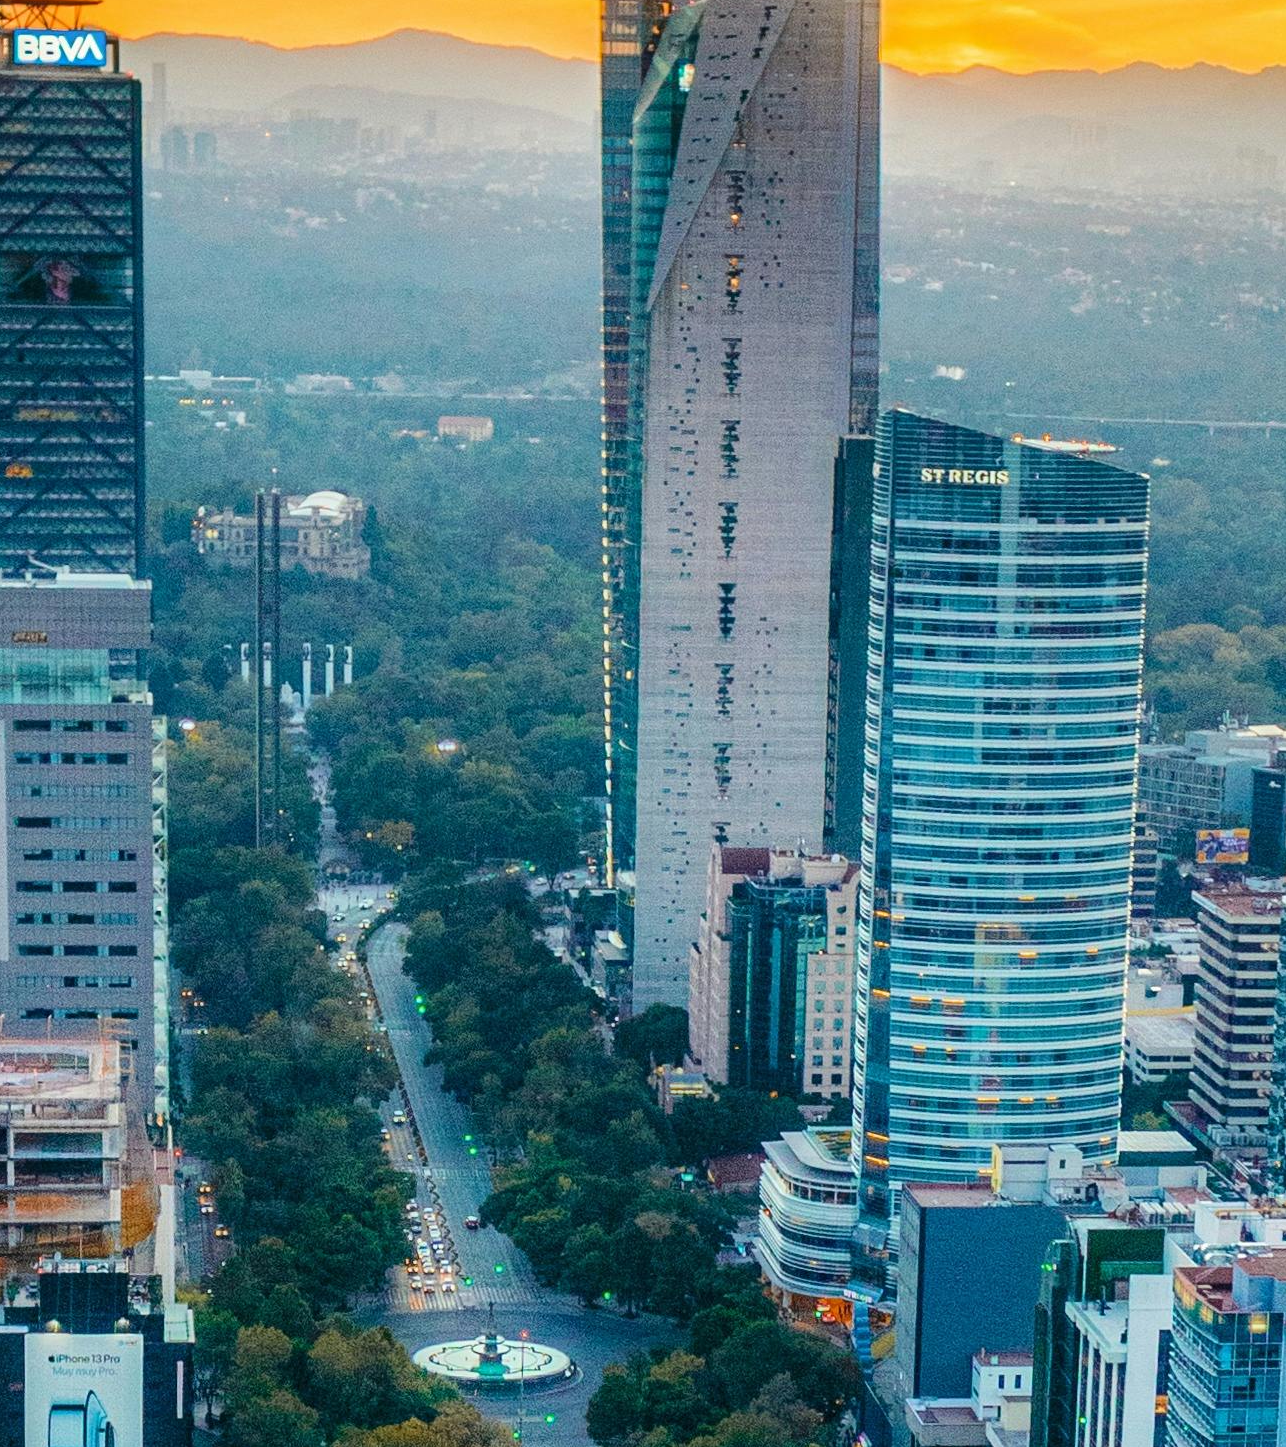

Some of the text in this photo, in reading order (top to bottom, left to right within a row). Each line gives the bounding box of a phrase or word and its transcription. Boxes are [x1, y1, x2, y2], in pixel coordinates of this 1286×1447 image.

[17, 33, 104, 63] BBVA
[921, 467, 1010, 485] ST REGIS
[56, 1354, 121, 1363] iPhone 13 Pro
